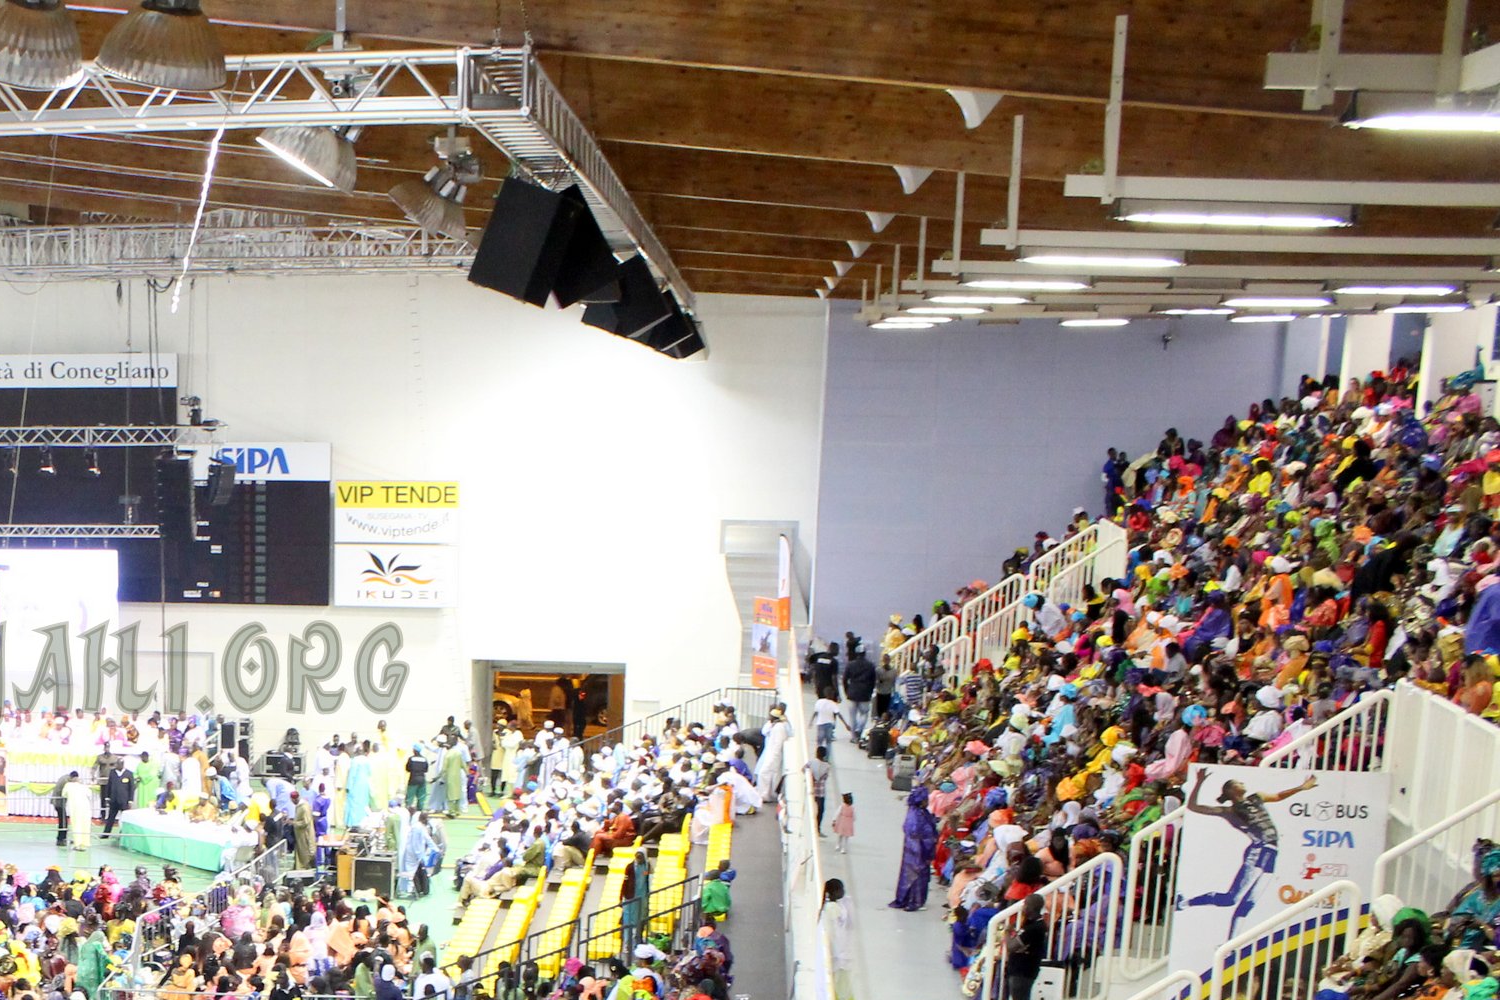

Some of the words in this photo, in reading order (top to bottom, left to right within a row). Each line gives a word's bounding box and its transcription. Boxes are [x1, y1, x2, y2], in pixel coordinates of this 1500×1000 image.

[23, 361, 43, 380] di
[50, 361, 169, 385] Conegliano
[338, 485, 374, 504] VIP
[380, 485, 458, 504] TENDE
[1301, 829, 1355, 849] SIPA
